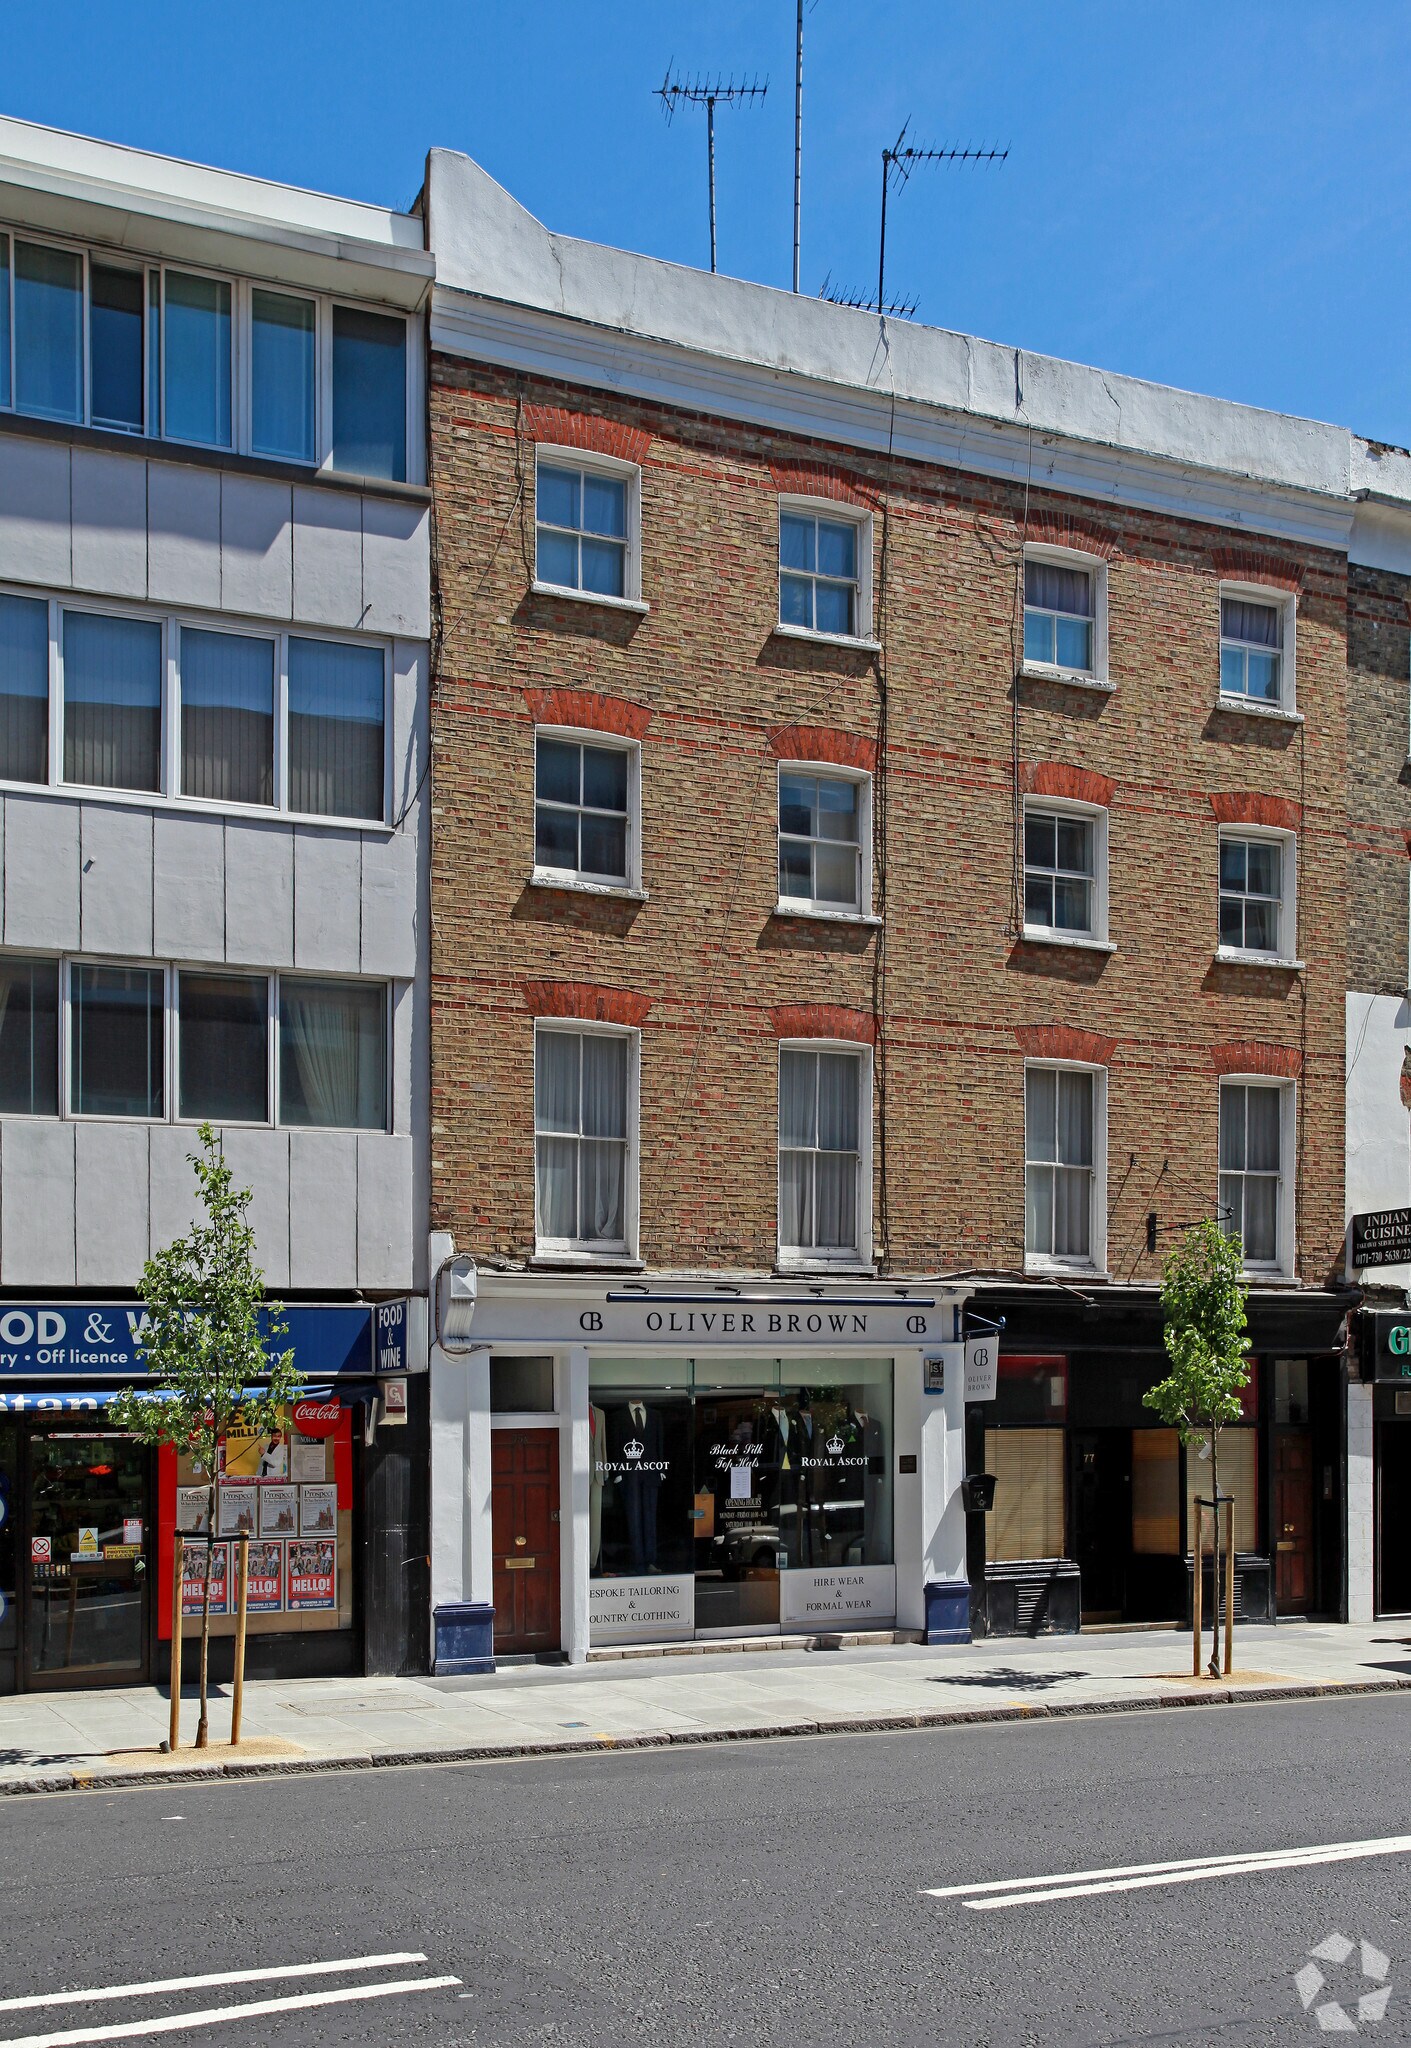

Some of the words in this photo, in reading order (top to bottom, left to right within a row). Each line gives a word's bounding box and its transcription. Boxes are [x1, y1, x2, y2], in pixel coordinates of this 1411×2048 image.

[1367, 1211, 1409, 1227] INDIAN
[1364, 1224, 1411, 1240] CUISINE
[1356, 1251, 1383, 1265] 0171-730
[379, 1304, 403, 1329] FOOD
[646, 1312, 757, 1332] OLIVER
[768, 1313, 868, 1333] BROWN
[83, 1312, 115, 1344] &
[387, 1328, 394, 1345] &
[36, 1349, 65, 1364] Off
[70, 1349, 128, 1364] licence
[380, 1346, 401, 1369] WINE
[968, 1374, 992, 1383] OLIVER
[968, 1384, 991, 1392] BROWN
[295, 1403, 340, 1420] Coca-Cola
[710, 1443, 739, 1456] Black
[743, 1443, 764, 1455] Silk
[714, 1456, 733, 1473] Top
[735, 1457, 760, 1468] Hats
[801, 1456, 834, 1467] ROYAL
[836, 1456, 870, 1467] ASCOT
[1083, 1454, 1095, 1463] 77
[595, 1461, 632, 1471] ROYAL
[634, 1460, 670, 1471] ASCOT
[181, 1492, 209, 1502] Prospec
[223, 1490, 253, 1500] Prospect
[264, 1490, 294, 1499] Prospect
[304, 1489, 334, 1499] Prospect
[725, 1498, 745, 1507] OPENING
[248, 1580, 277, 1594] ELLO!
[292, 1578, 331, 1592] HELLO!
[813, 1577, 835, 1587] HIRE
[838, 1576, 864, 1586] WEAR
[183, 1582, 223, 1596] HELO!
[589, 1588, 626, 1598] ESPOKE
[628, 1586, 680, 1597] TAILORING
[835, 1590, 842, 1598] &
[628, 1601, 636, 1609] &
[806, 1602, 844, 1611] FORMAL
[845, 1600, 872, 1609] WEAR
[589, 1613, 628, 1624] OUNTRY
[631, 1611, 680, 1622] CLOTHING
